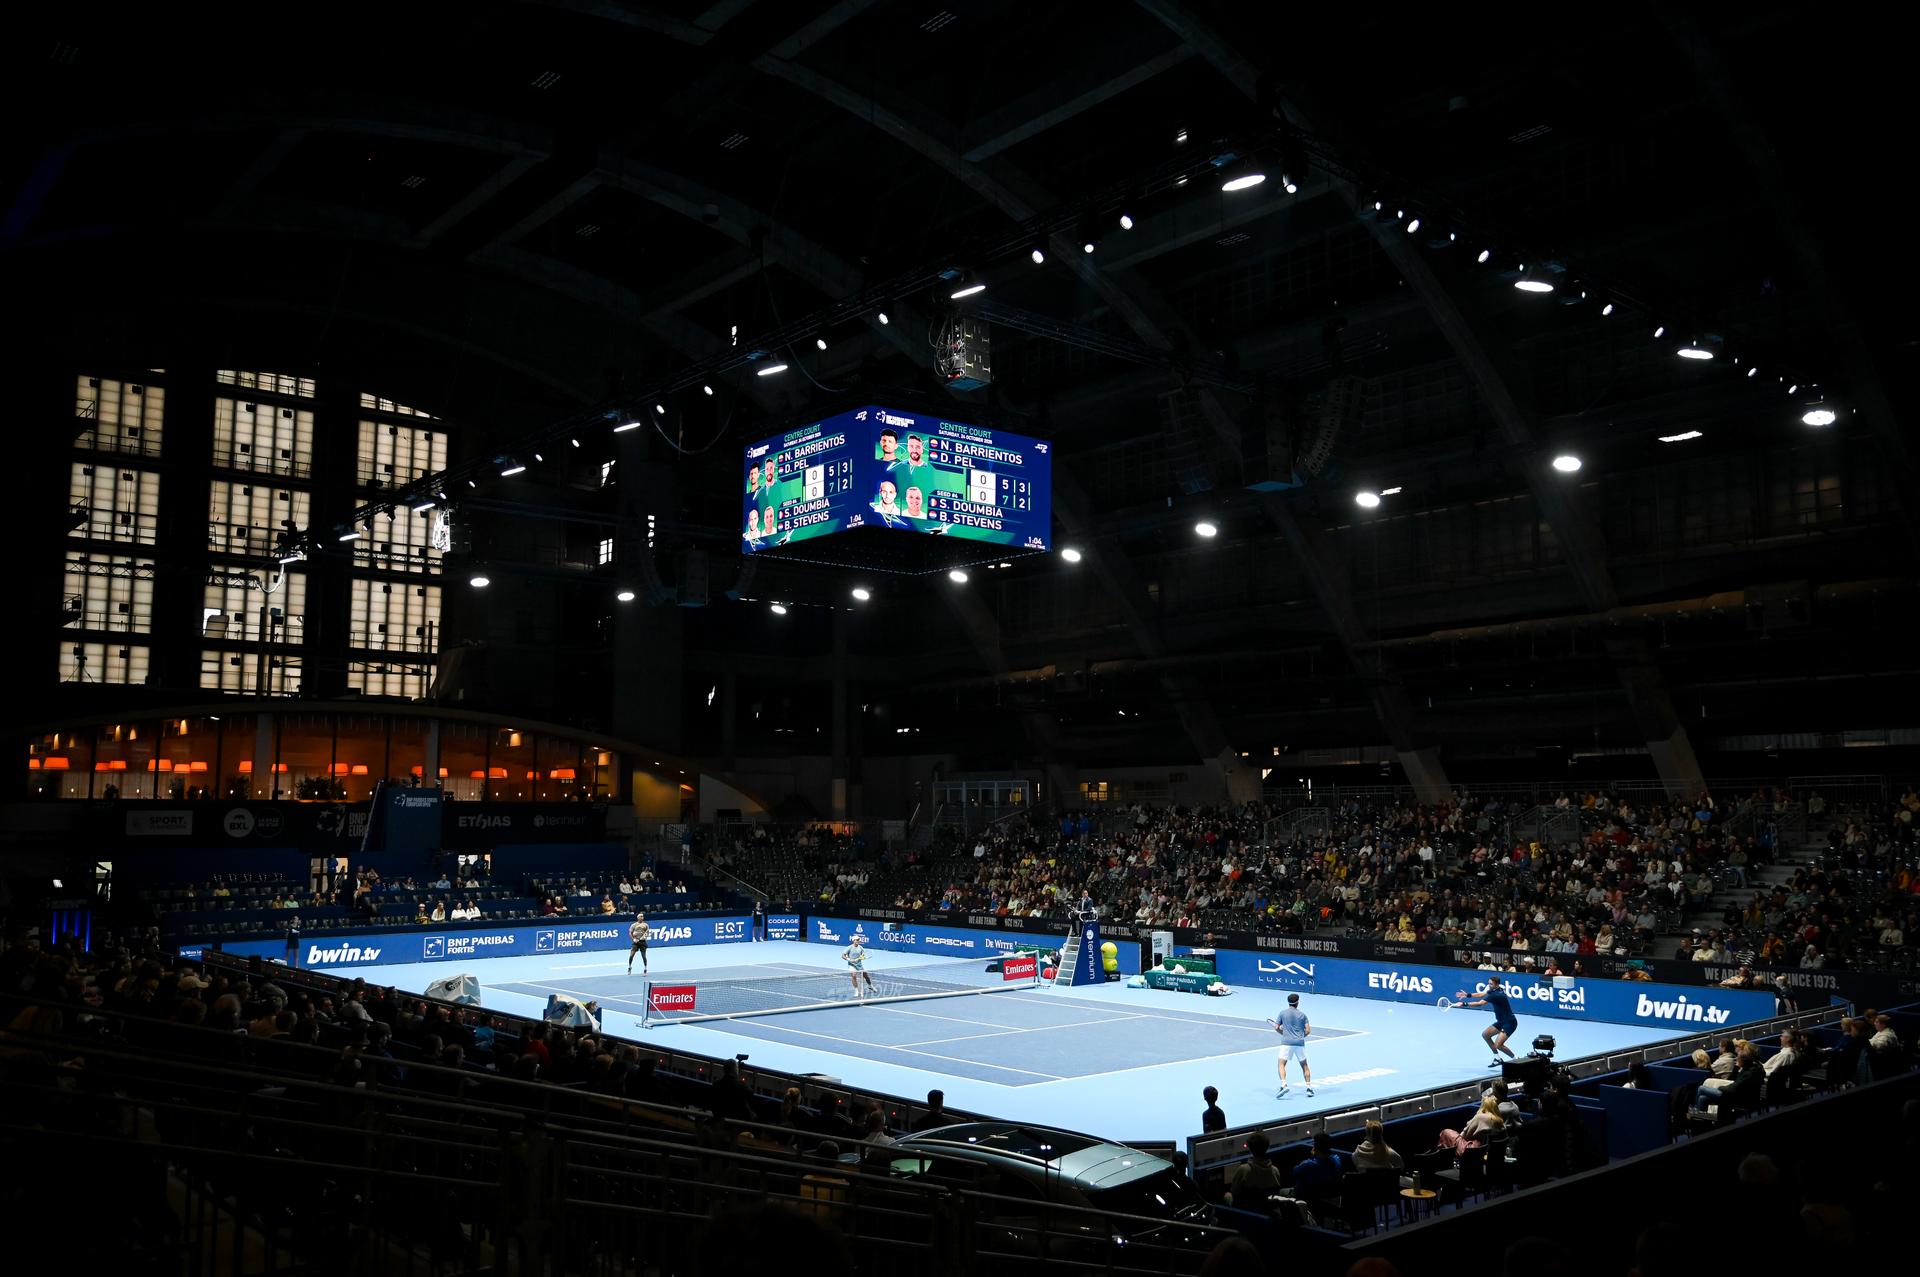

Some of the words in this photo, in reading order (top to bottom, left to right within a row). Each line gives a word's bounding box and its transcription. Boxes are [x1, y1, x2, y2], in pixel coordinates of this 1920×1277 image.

[784, 429, 804, 442] CENTRE
[804, 424, 821, 436] COURT
[940, 422, 968, 434] CENTRE
[969, 428, 992, 438] COURT
[785, 452, 792, 461] N.
[795, 435, 845, 456] BARRIENTOS
[941, 440, 952, 451] N.
[956, 442, 1022, 464] BARRIENTOS
[785, 464, 792, 473] D.
[794, 459, 809, 471] PEL
[940, 454, 951, 463] D.
[955, 456, 975, 468] PEL
[812, 470, 817, 480] 0
[829, 466, 834, 476] 5
[842, 462, 848, 472] 3
[812, 487, 817, 496] 0
[829, 482, 834, 492] 7
[842, 479, 848, 489] 2
[980, 475, 986, 484] 0
[1002, 480, 1009, 490] 5
[1019, 482, 1025, 492] 3
[785, 509, 792, 518] S.
[794, 498, 830, 516] DOUMBIA
[980, 492, 986, 501] 0
[1002, 496, 1008, 505] 7
[1019, 499, 1025, 508] 2
[940, 499, 950, 509] S.
[953, 502, 1003, 518] DOUMBIA
[785, 521, 792, 530] B.
[794, 511, 829, 528] STEVENS
[940, 512, 950, 521] B.
[953, 514, 1002, 529] STEVENS
[1028, 536, 1042, 545] 1:04
[558, 932, 577, 940] BNP
[580, 930, 618, 939] PARIBAS
[715, 922, 744, 933] EQT
[448, 938, 470, 947] BNP
[472, 935, 514, 946] PARIBAS
[879, 932, 916, 944] CODEAGE
[926, 937, 974, 947] PORSCHE
[1256, 936, 1266, 946] WE
[1267, 937, 1278, 947] ARE
[1279, 938, 1302, 950] TENNIS.
[1304, 939, 1322, 950] SINCE
[1323, 941, 1339, 952] 1973.
[307, 942, 382, 964] bwin.tv
[448, 946, 475, 954] FORTIS
[1005, 964, 1034, 974] Emirates
[1259, 976, 1314, 986] LUXILON
[1704, 968, 1720, 980] WE
[1813, 974, 1840, 990] 1973.
[654, 993, 694, 1004] Emirates
[1527, 983, 1554, 1001] del
[1558, 987, 1584, 1004] sol
[1636, 994, 1730, 1024] bwin.tv
